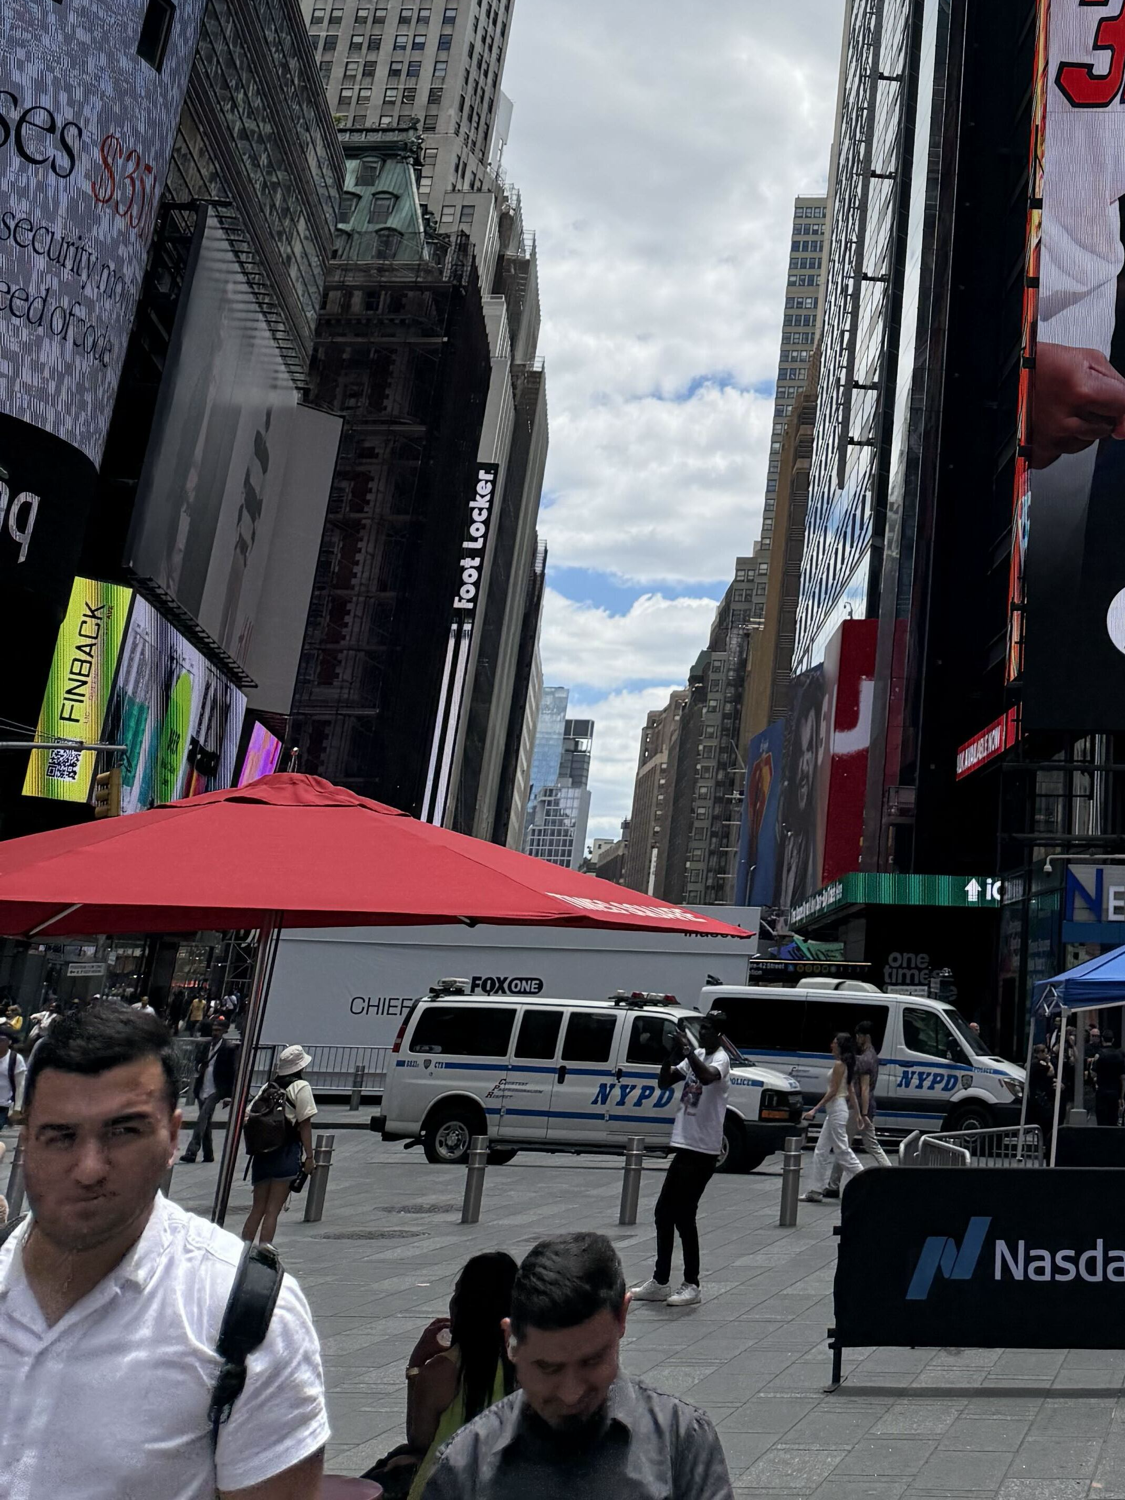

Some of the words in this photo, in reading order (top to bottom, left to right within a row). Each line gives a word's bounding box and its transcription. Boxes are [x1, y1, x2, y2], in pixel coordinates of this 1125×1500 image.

[0, 211, 98, 291] security
[50, 301, 81, 342] of
[453, 557, 481, 610] Foot
[59, 601, 106, 724] FINBACK
[888, 952, 929, 968] one
[470, 976, 509, 995] FOX
[508, 978, 541, 993] ONE
[591, 1083, 675, 1109] NYPD
[897, 1069, 959, 1092] NYPD
